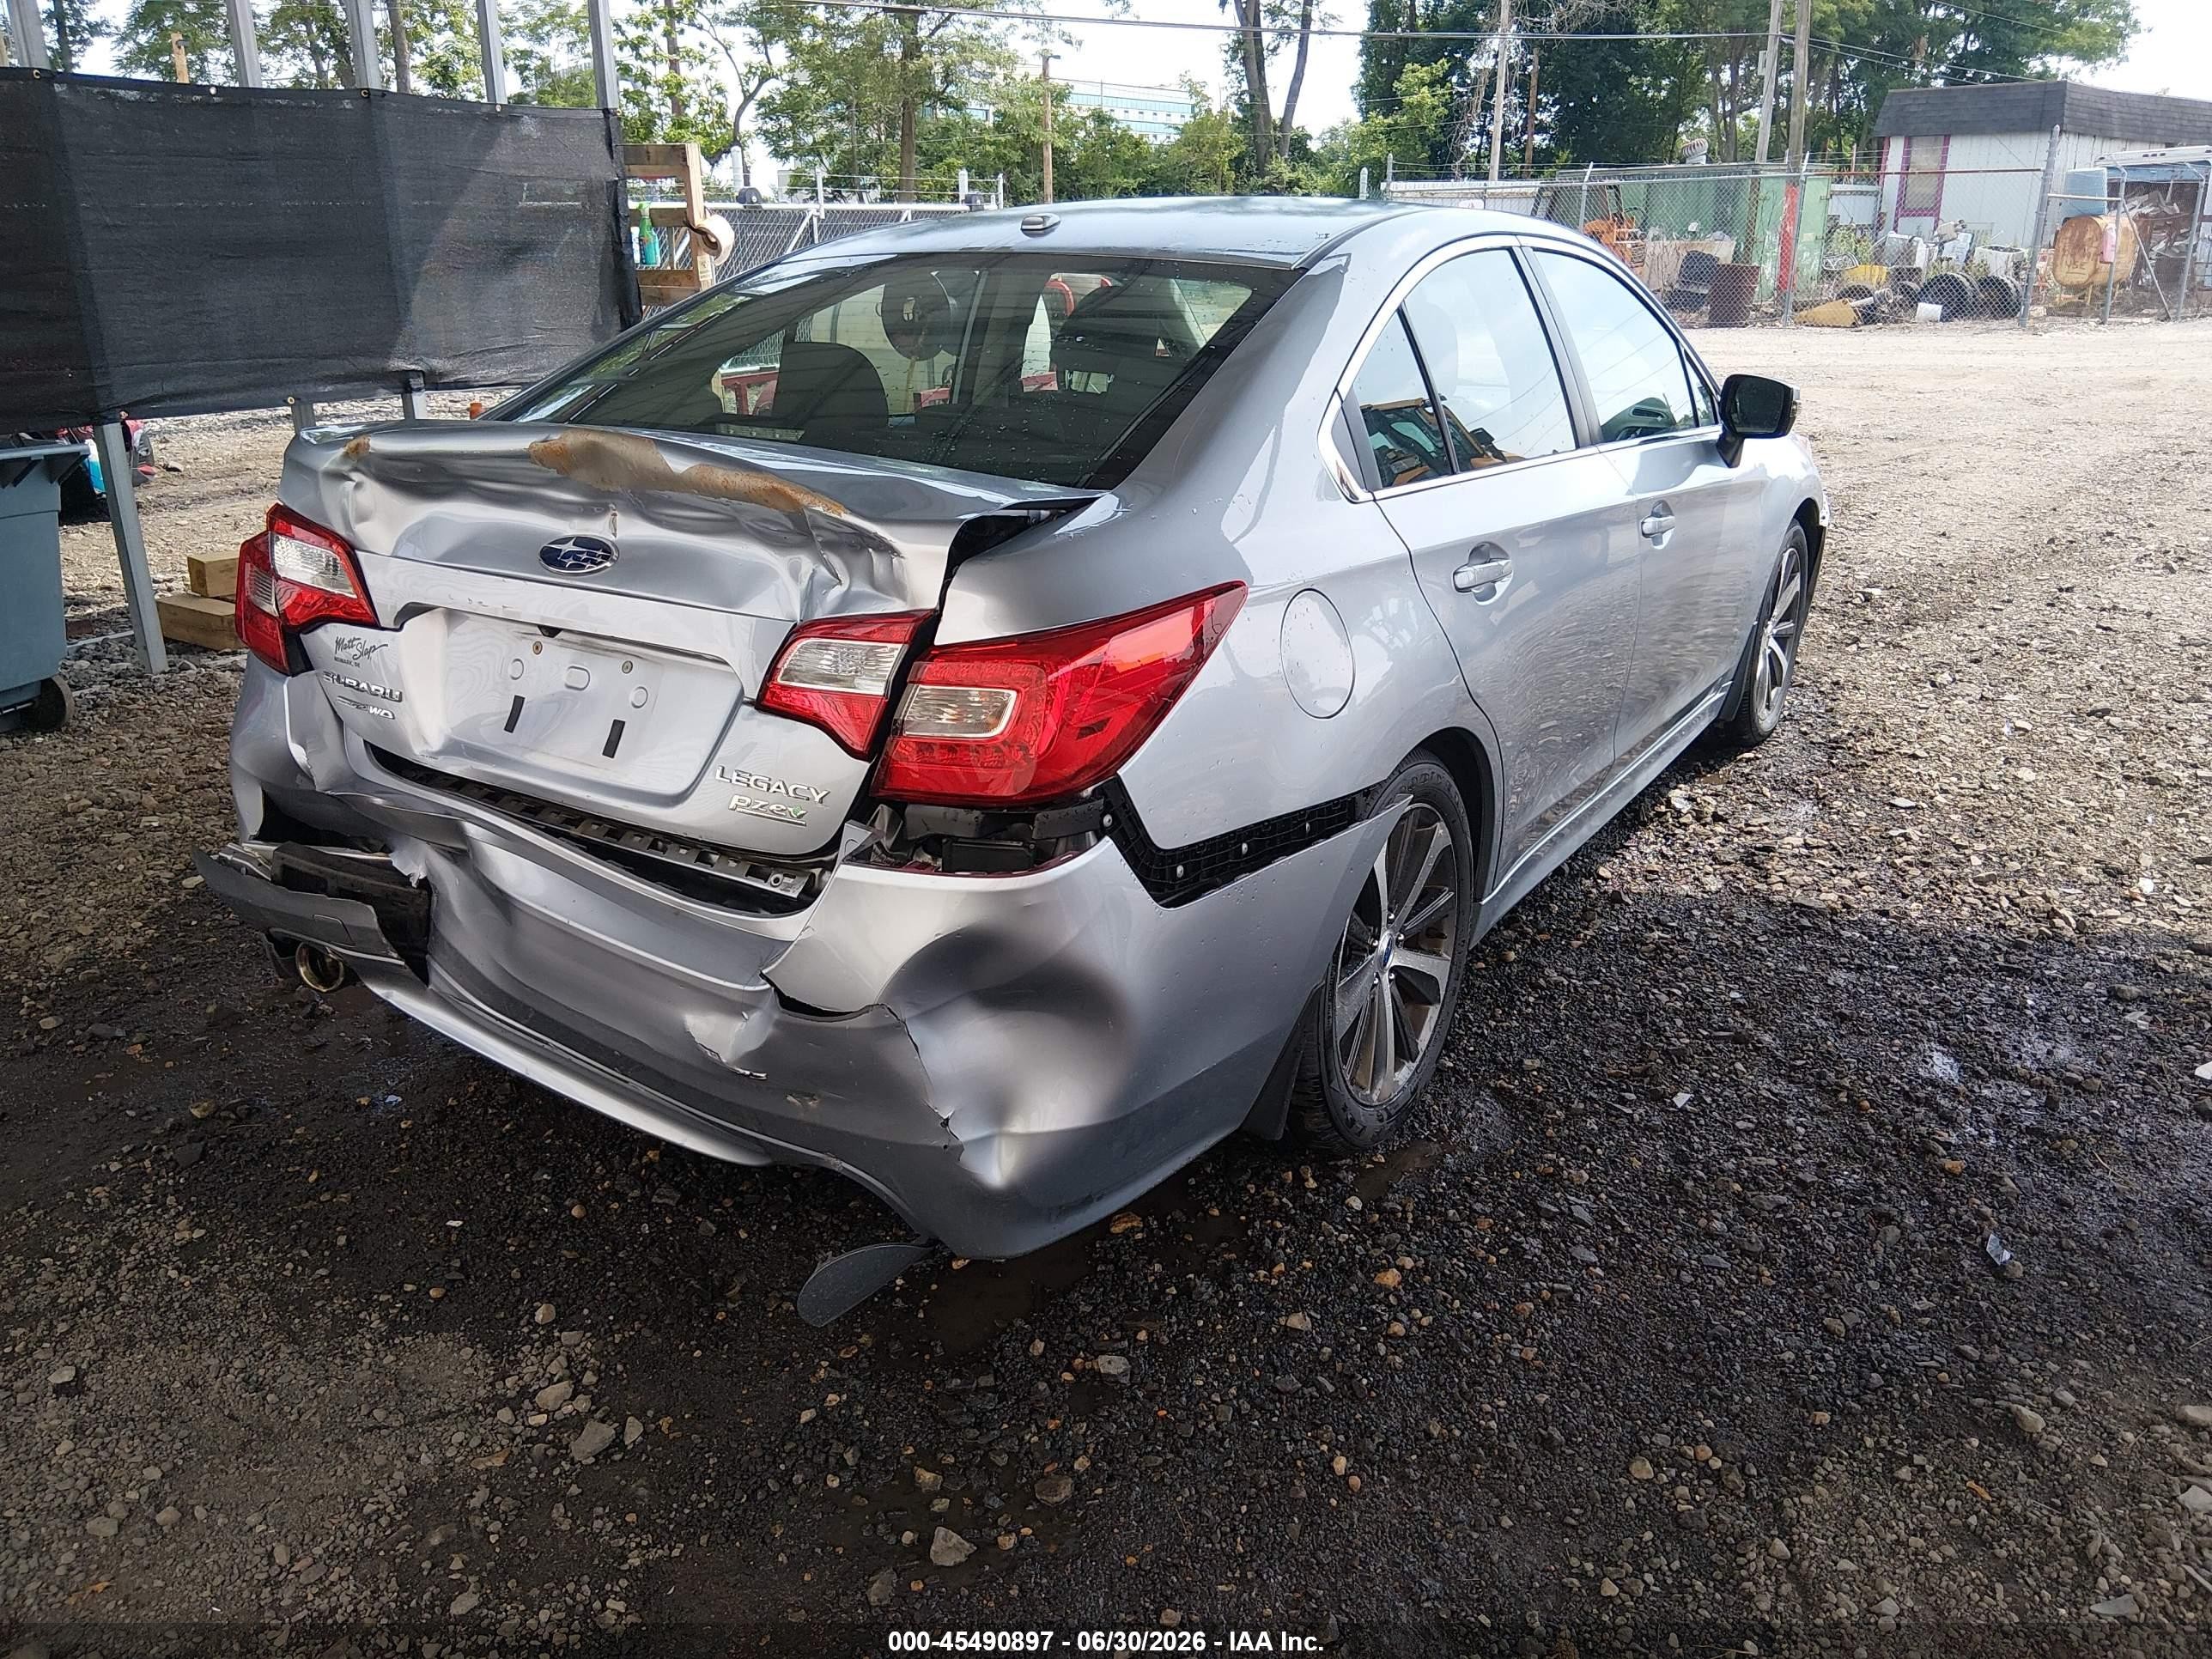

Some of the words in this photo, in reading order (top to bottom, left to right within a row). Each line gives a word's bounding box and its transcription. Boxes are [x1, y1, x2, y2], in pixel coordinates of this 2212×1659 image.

[334, 635, 362, 654] Matt
[352, 640, 389, 660] Slap
[323, 671, 403, 702] SUBARU
[715, 764, 830, 804] LEGACY
